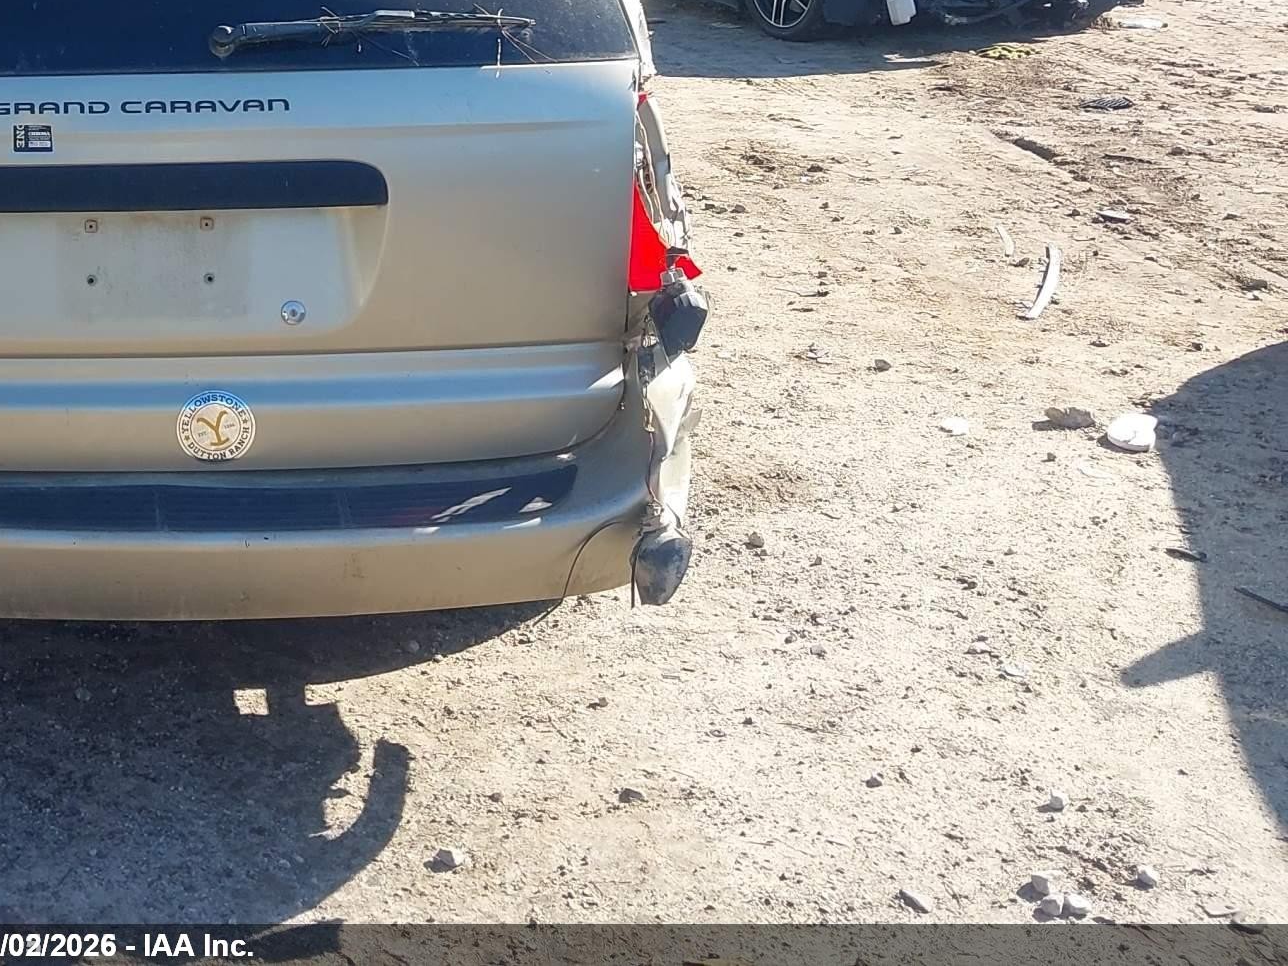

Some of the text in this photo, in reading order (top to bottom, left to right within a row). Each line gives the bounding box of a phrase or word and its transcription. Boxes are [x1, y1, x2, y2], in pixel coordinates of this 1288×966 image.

[120, 98, 290, 114] CARAVAN
[181, 394, 247, 435] YELLOWSTONE
[188, 426, 250, 460] DUTTON RANCH
